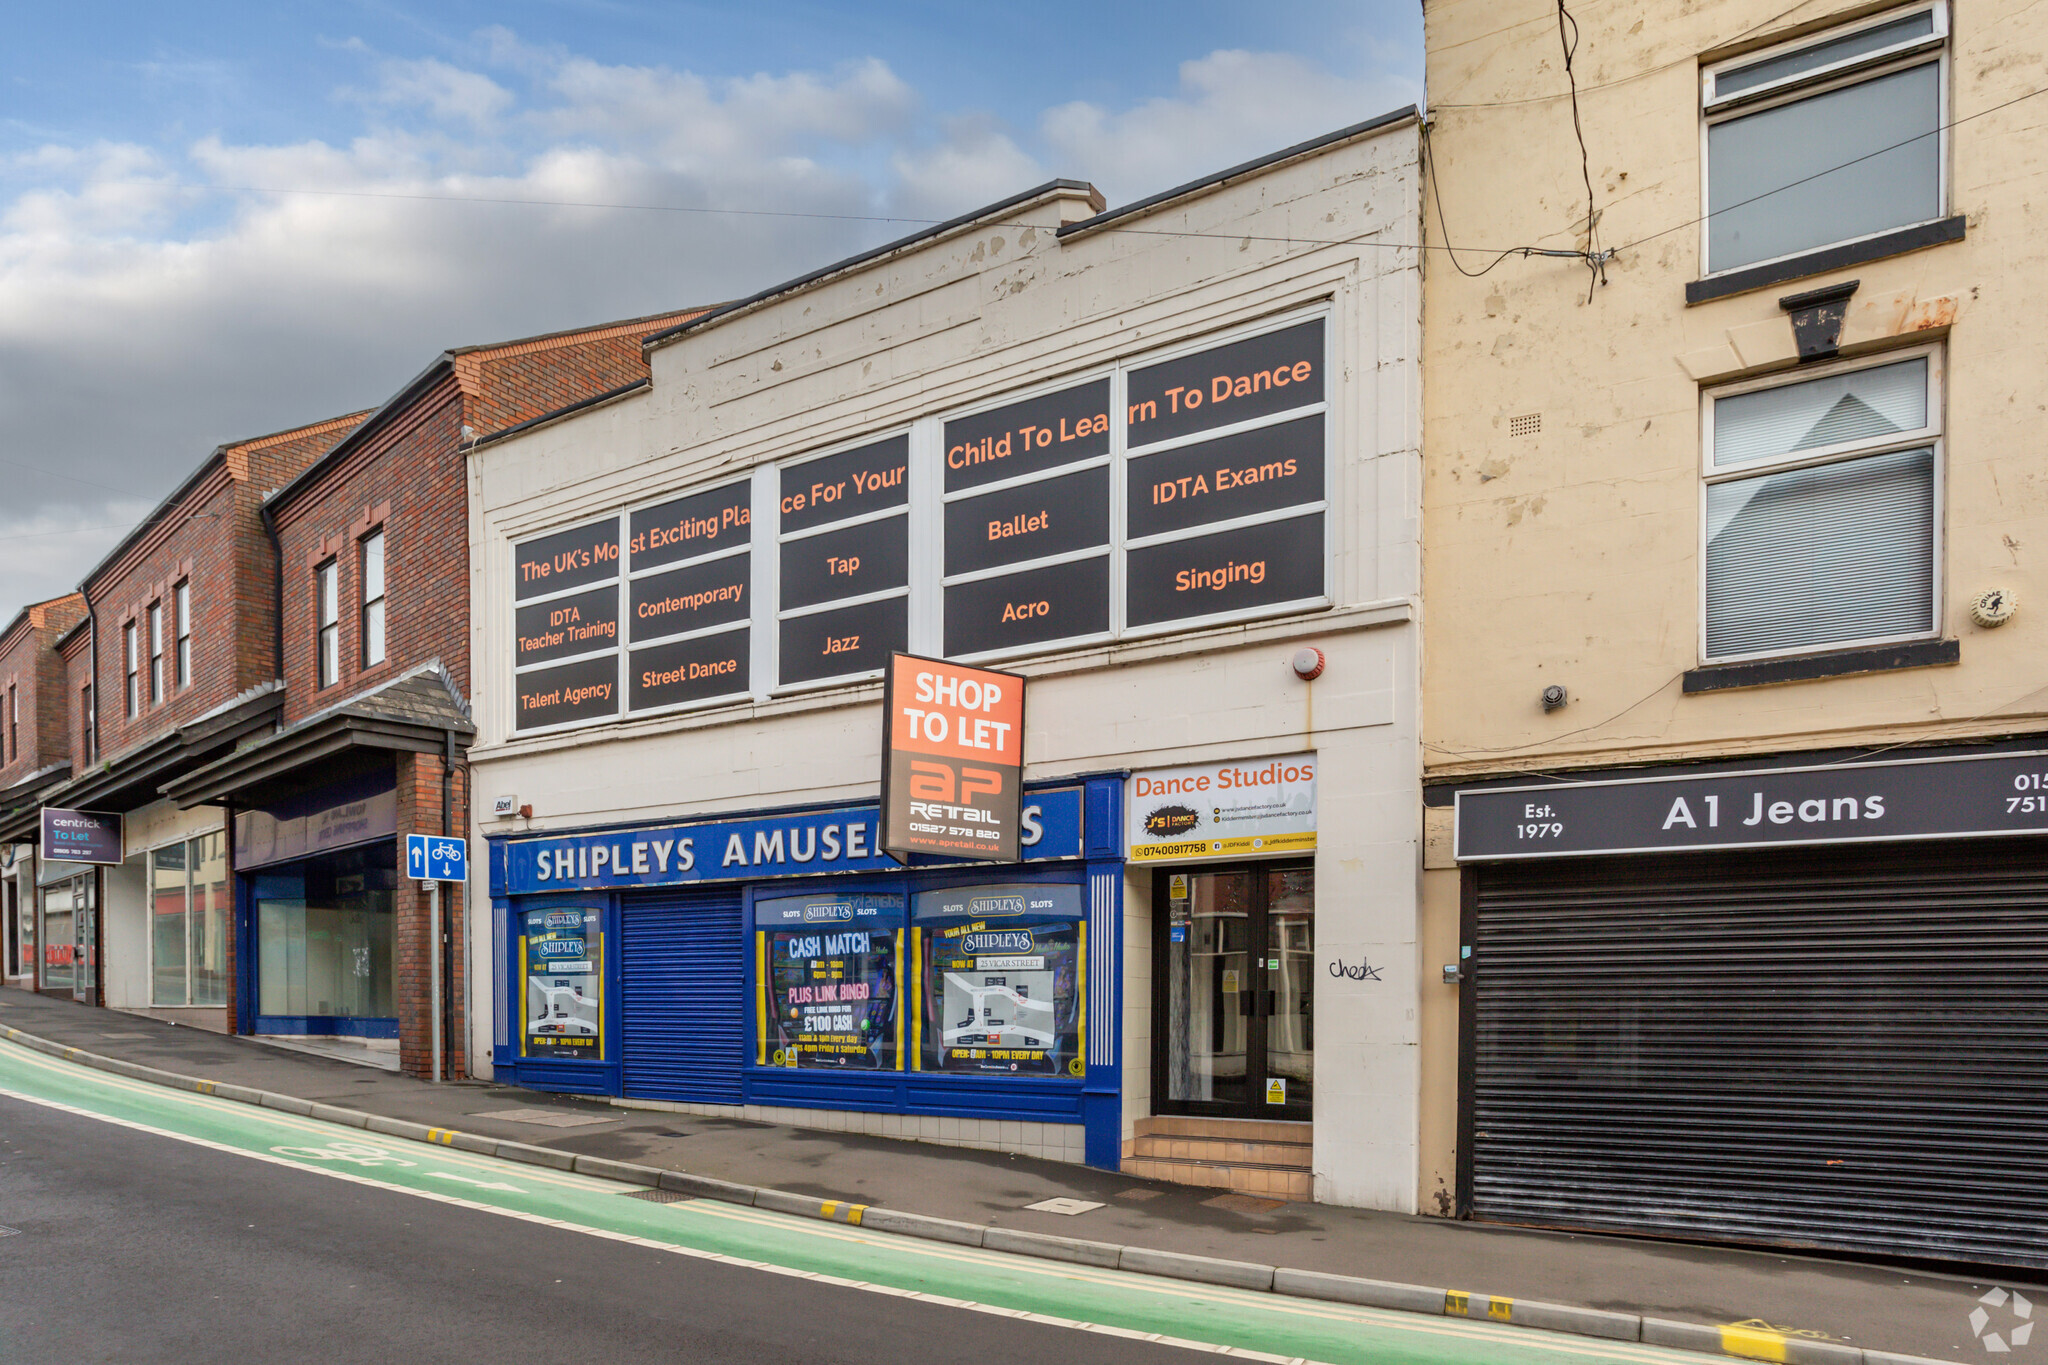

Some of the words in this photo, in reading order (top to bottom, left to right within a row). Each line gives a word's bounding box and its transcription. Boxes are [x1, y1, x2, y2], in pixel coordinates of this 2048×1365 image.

[521, 559, 550, 582] The
[554, 548, 590, 572] UK's
[650, 516, 718, 550] Exciting
[811, 481, 845, 507] For
[852, 465, 906, 495] Your
[947, 432, 1011, 470] Child
[1019, 425, 1053, 451] To
[1166, 386, 1203, 415] To
[1212, 360, 1312, 404] Dance
[1153, 475, 1210, 505] IDTA
[1216, 457, 1298, 493] Exams
[988, 510, 1049, 541] Ballet
[827, 555, 860, 577] Tap
[1175, 560, 1266, 592] Singing
[638, 583, 743, 619] Contemporary
[550, 607, 580, 626] IDTA
[1001, 599, 1050, 623] Acro
[519, 630, 564, 652] Teacher
[567, 619, 616, 645] Training
[822, 636, 860, 655] Jazz
[642, 668, 686, 688] Street
[689, 659, 737, 679] Dance
[521, 689, 560, 710] Talent
[564, 682, 612, 705] Agency
[915, 672, 1002, 713] SHOP
[903, 707, 949, 743] TO
[958, 716, 1011, 752] LET
[1136, 775, 1211, 797] Dance
[1217, 763, 1314, 789] Studios
[496, 800, 511, 809] Abel
[1525, 804, 1556, 818] Est.
[1662, 795, 1718, 829] A1
[1743, 793, 1885, 826] Jeans
[2006, 796, 2045, 813] 751
[53, 819, 100, 828] centrick
[1171, 814, 1195, 822] DANCE
[53, 830, 68, 840] To
[71, 831, 89, 841] Let
[909, 823, 945, 834] 01527
[949, 826, 974, 837] 578
[976, 829, 1000, 840] 820
[1517, 823, 1563, 839] 1979
[910, 836, 1000, 852] www.apretail.co.uk
[1144, 843, 1206, 856] 07400917758
[537, 838, 696, 881] SHIPLEYS
[783, 910, 801, 918] SLOTS
[806, 905, 851, 920] SHIPLEYS
[943, 904, 964, 912] SLOTS
[970, 898, 1023, 915] SHIPLEYS
[1030, 900, 1053, 909] SLOTS
[547, 915, 579, 926] SHIPLEYS
[944, 927, 960, 939] YOUR
[960, 924, 971, 935] ALL
[971, 921, 986, 932] NEW
[541, 941, 583, 955] SHIPLEYS
[789, 936, 821, 958] CASH
[825, 932, 870, 956] MATCH
[964, 932, 1031, 952] SHIPLEYS
[952, 960, 966, 969] NOW
[967, 960, 974, 968] AT
[1009, 959, 1040, 967] STREET
[789, 987, 812, 1003] PLUS
[814, 985, 838, 1002] LINK
[840, 983, 869, 1000] BINGO
[804, 1015, 831, 1031] £100
[833, 1015, 853, 1031] CASH
[830, 1035, 846, 1043] Every
[846, 1034, 858, 1043] day
[819, 1044, 835, 1054] Friday
[840, 1045, 867, 1055] Saturday
[952, 1049, 970, 1058] OPEN:
[991, 1050, 1010, 1059] 10PM
[1011, 1050, 1030, 1059] EVERY
[1031, 1051, 1044, 1060] DAY
